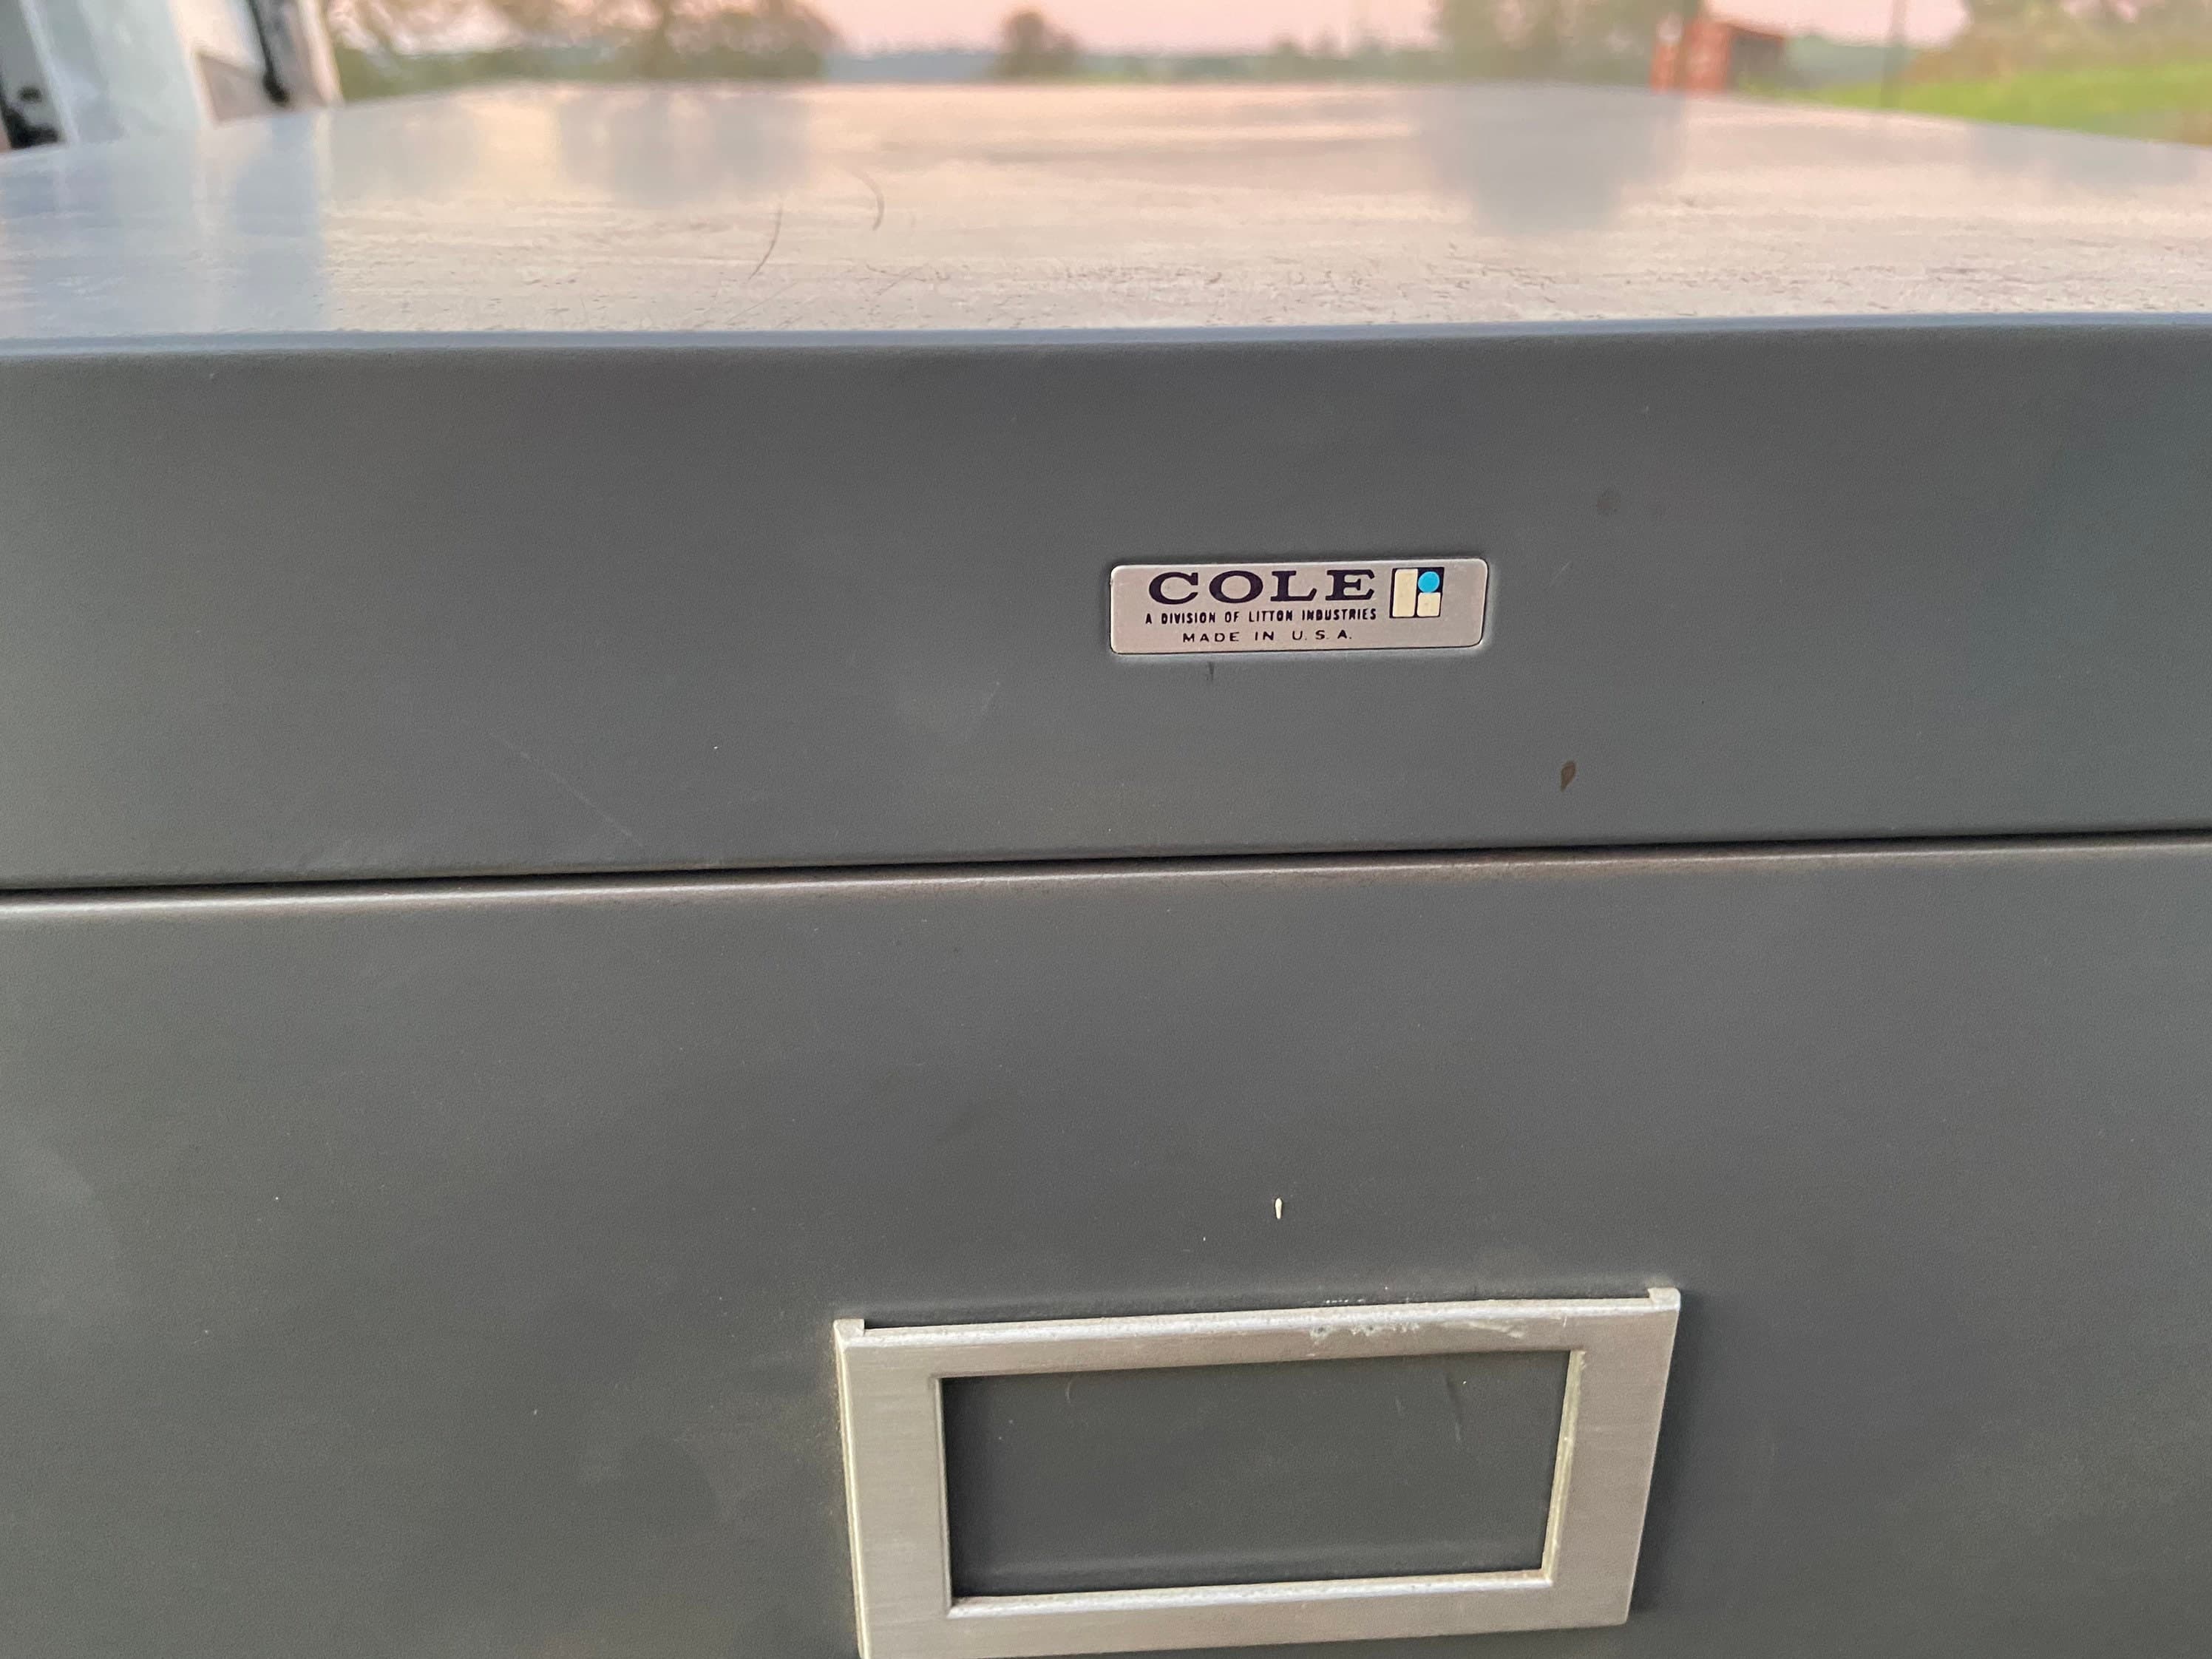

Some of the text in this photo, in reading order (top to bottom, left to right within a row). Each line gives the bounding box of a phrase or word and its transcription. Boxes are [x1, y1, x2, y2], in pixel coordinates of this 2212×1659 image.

[1148, 569, 1375, 605] COLE
[1144, 608, 1377, 625] A DIVISION OF LITTON INDUSTRIES
[1182, 631, 1240, 643] MADE
[1255, 631, 1275, 641] IN
